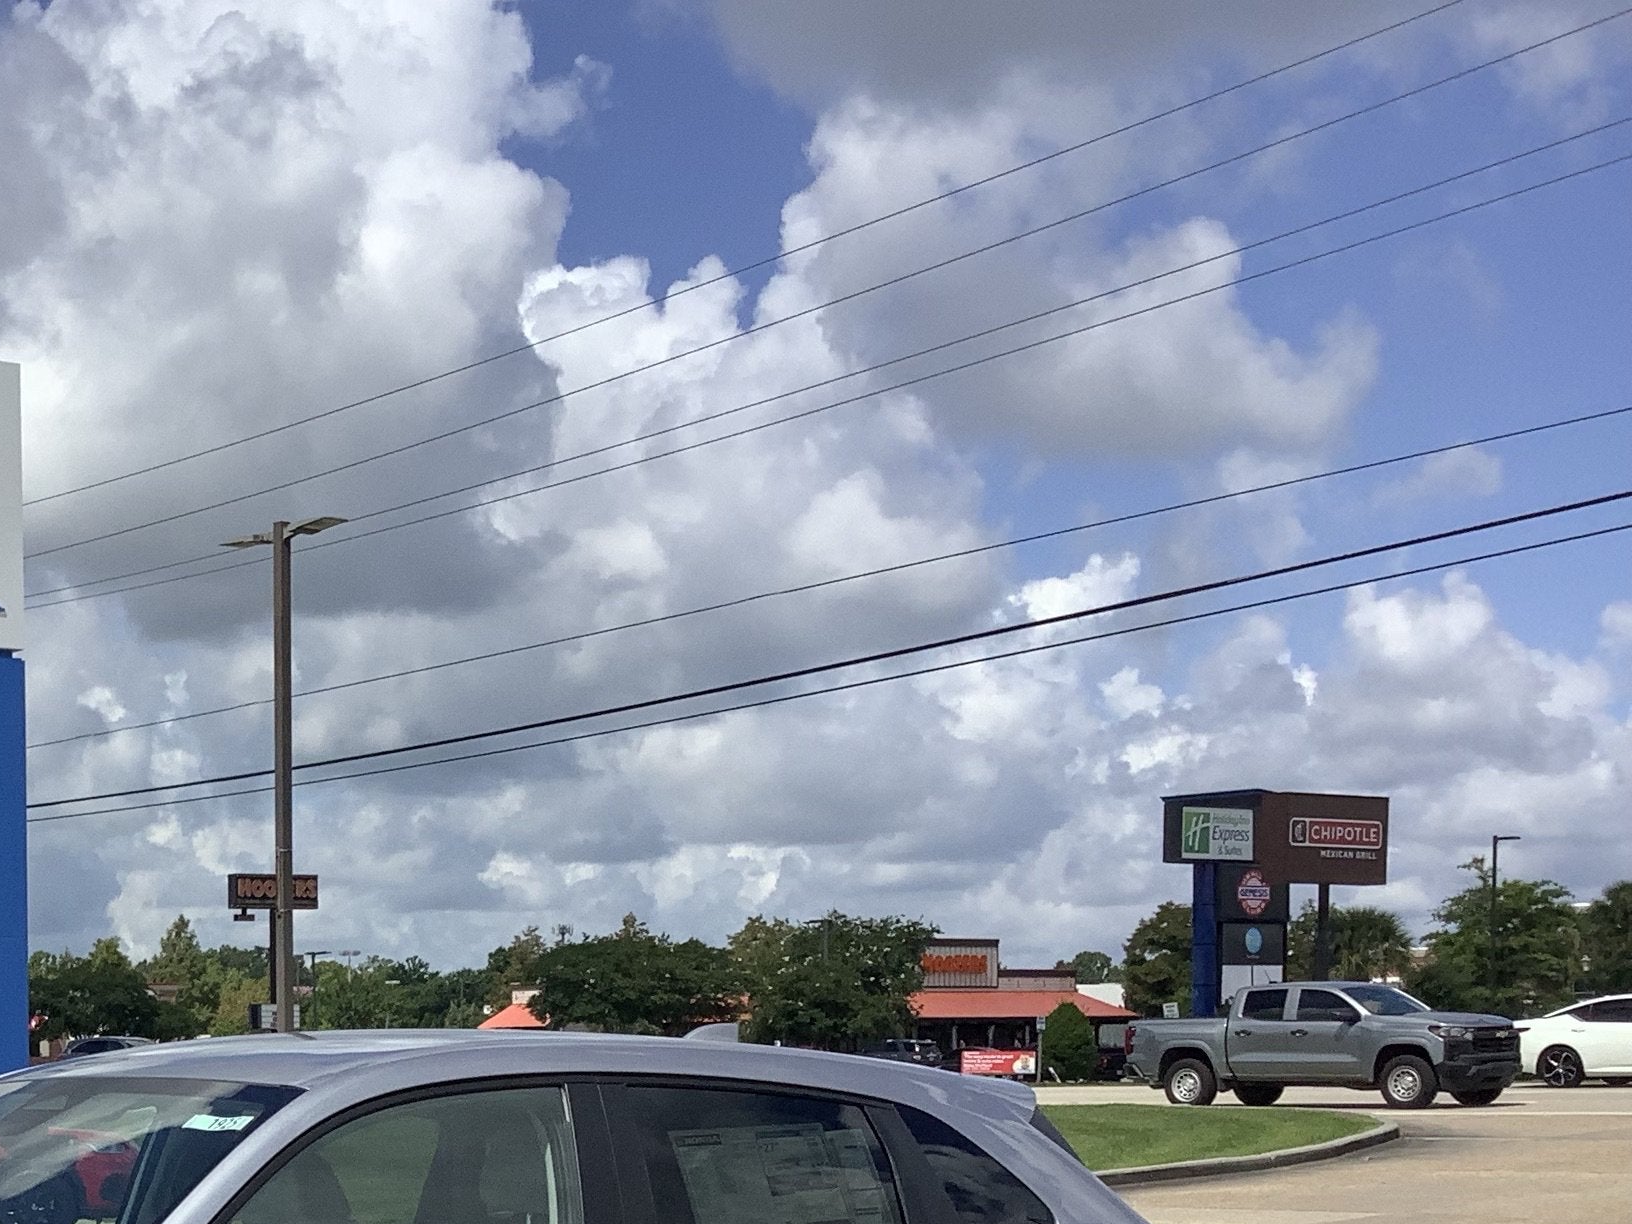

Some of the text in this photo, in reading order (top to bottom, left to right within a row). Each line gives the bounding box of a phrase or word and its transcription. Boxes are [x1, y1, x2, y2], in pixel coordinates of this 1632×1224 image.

[1212, 825, 1250, 845] Express
[1311, 825, 1378, 842] CHIPOTLE
[1320, 850, 1377, 860] MEXICAN GRILL
[238, 878, 316, 898] HOORS
